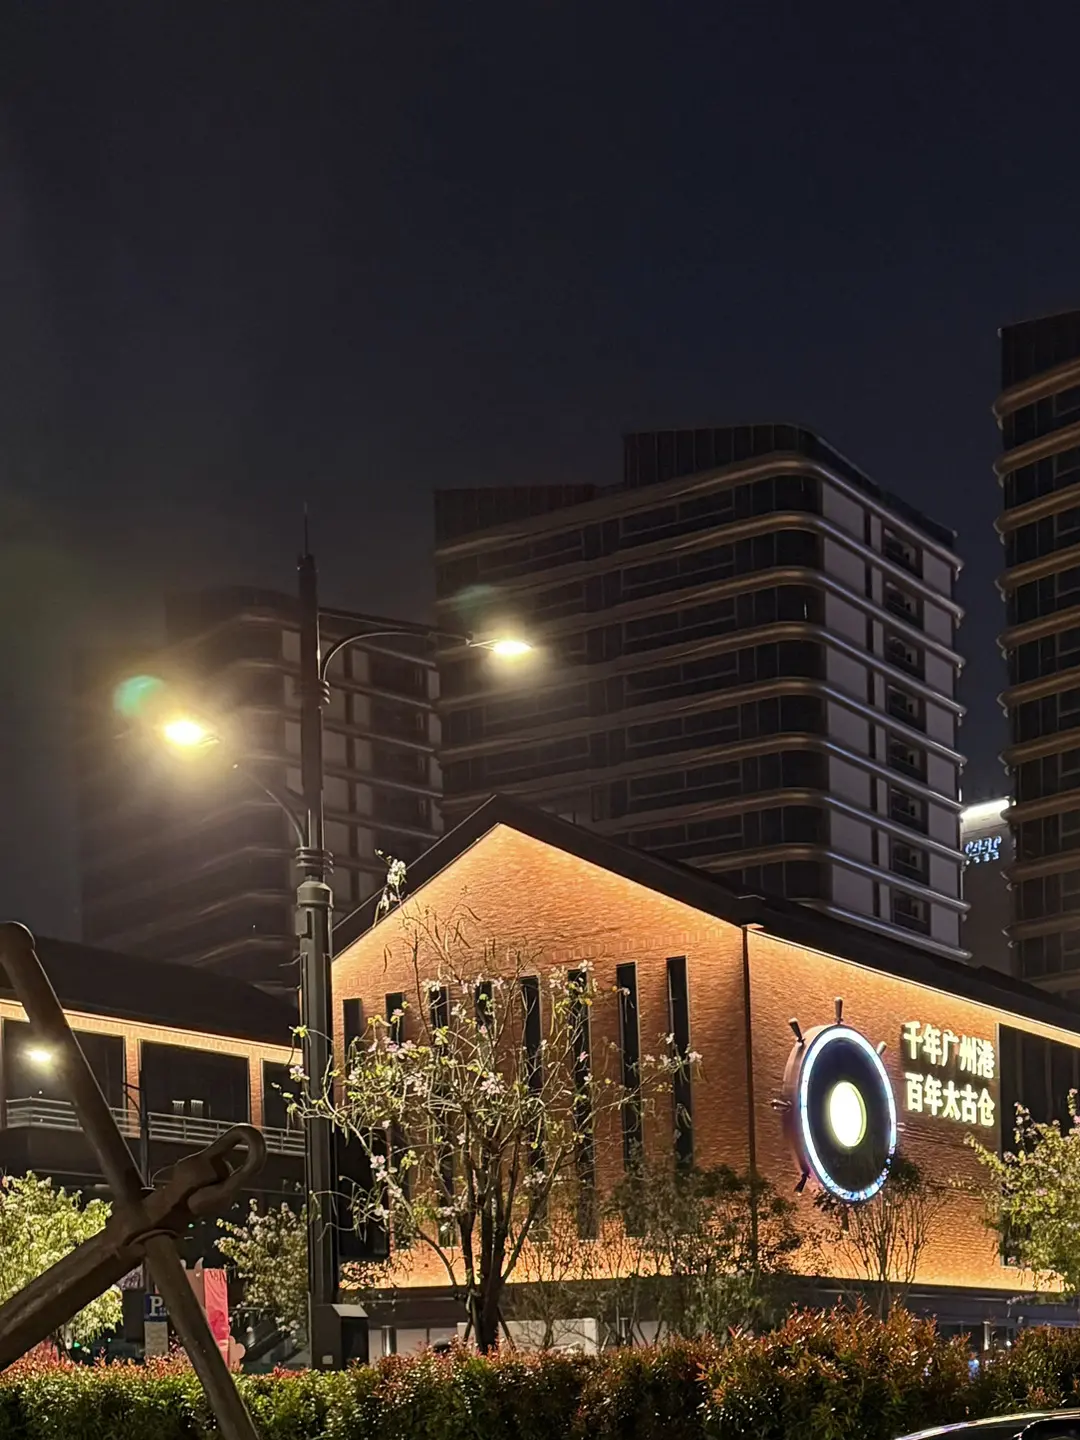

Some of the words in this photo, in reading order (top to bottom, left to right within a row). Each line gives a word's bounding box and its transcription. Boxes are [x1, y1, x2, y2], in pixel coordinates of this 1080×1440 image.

[903, 1020, 996, 1079] 千年广州港
[904, 1071, 996, 1127] 百年太古仓
